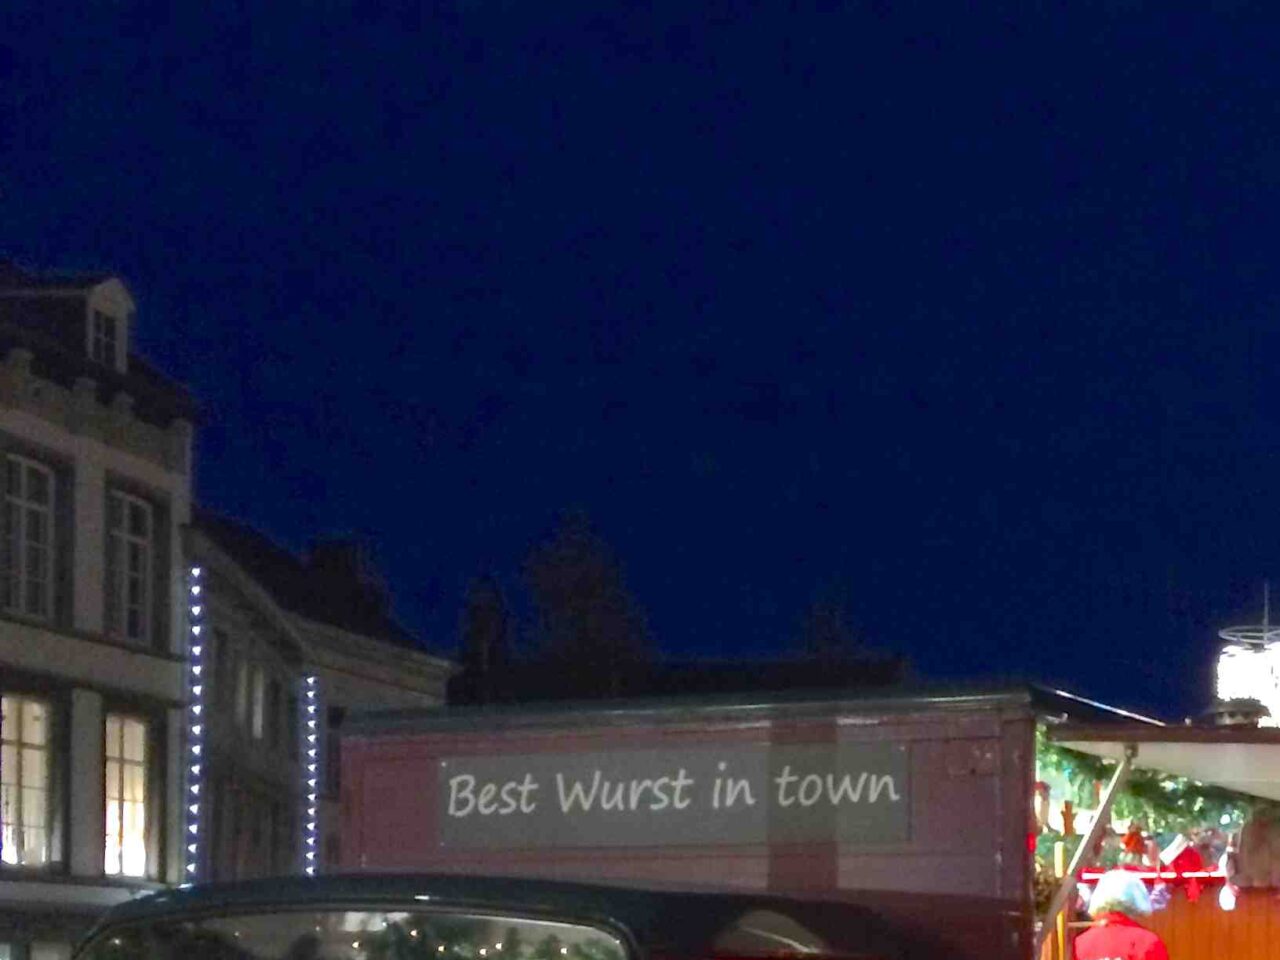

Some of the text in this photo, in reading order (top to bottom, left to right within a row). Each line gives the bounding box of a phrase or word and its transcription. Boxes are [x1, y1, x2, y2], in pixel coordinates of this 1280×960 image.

[447, 761, 901, 817] Best Wurst in town
